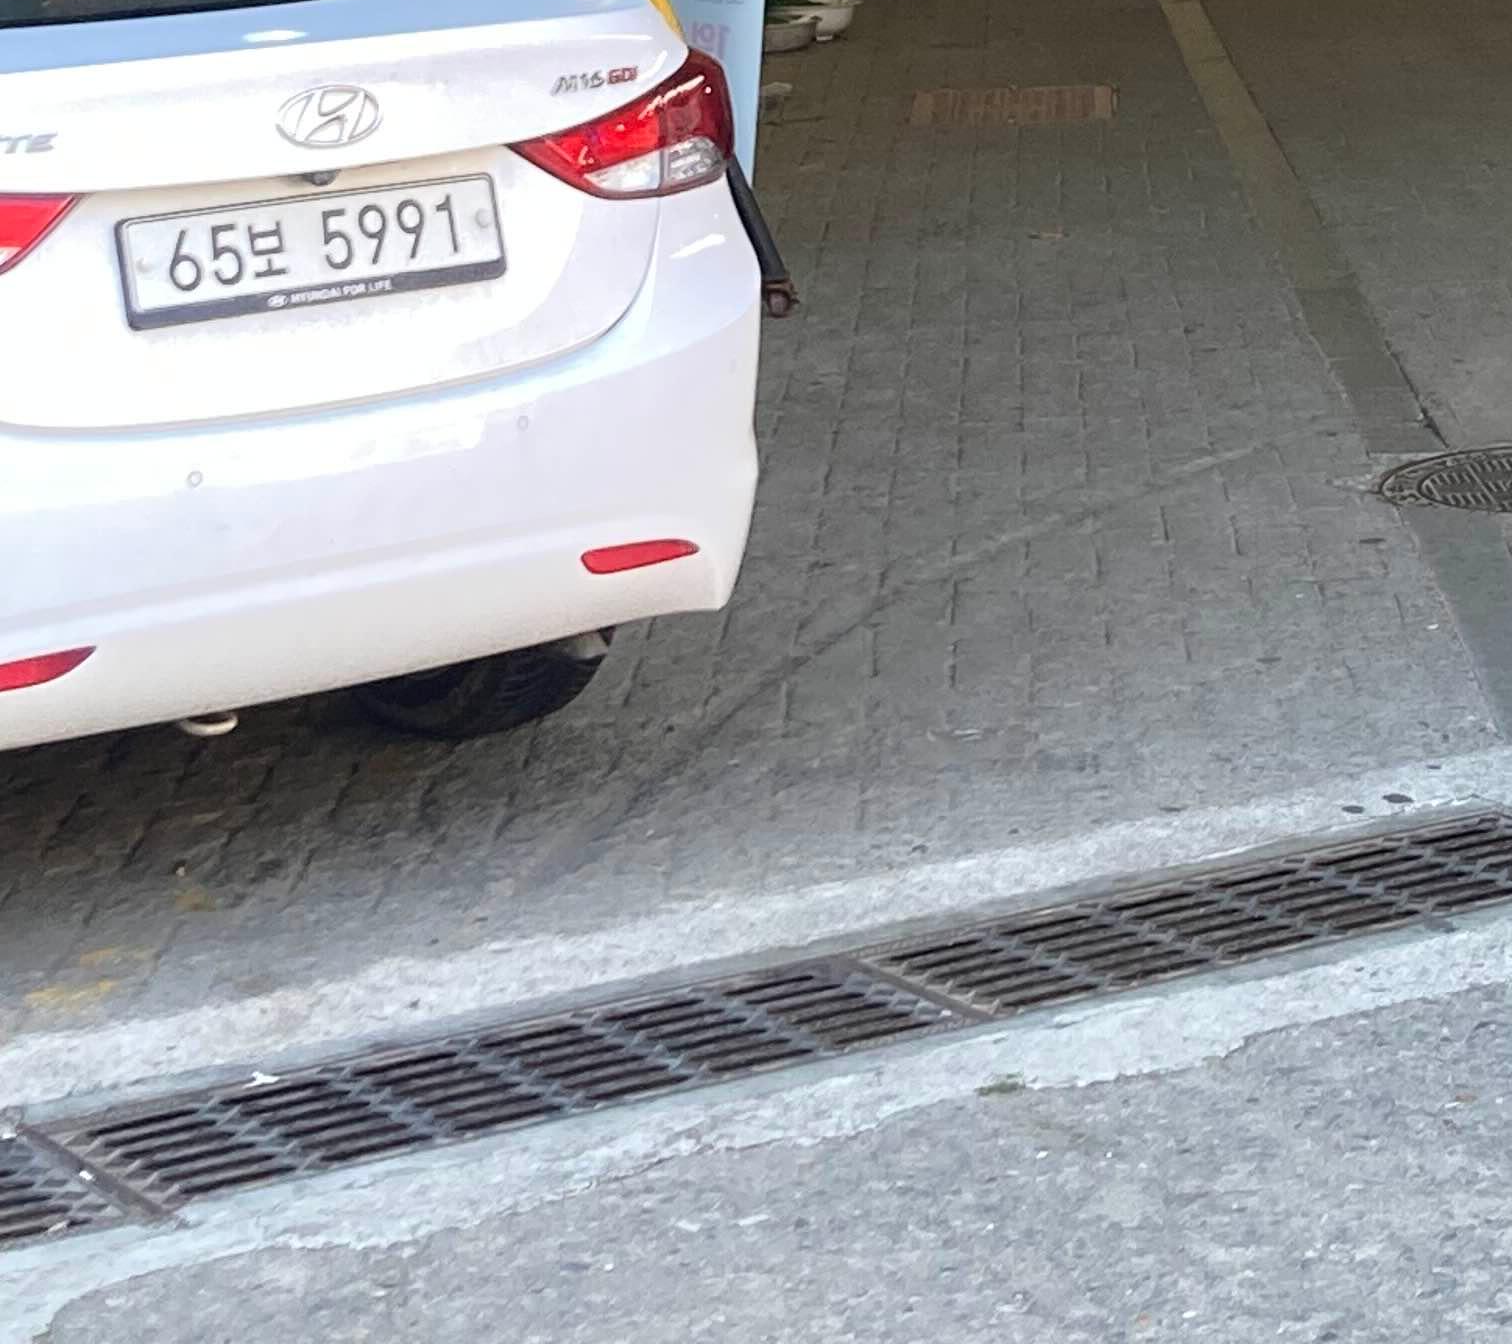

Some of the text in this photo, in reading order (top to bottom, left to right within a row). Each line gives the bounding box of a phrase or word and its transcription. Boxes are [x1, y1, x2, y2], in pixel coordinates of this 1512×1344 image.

[168, 193, 462, 292] 65보 5991
[343, 280, 367, 297] FOR
[367, 277, 393, 294] LIFE
